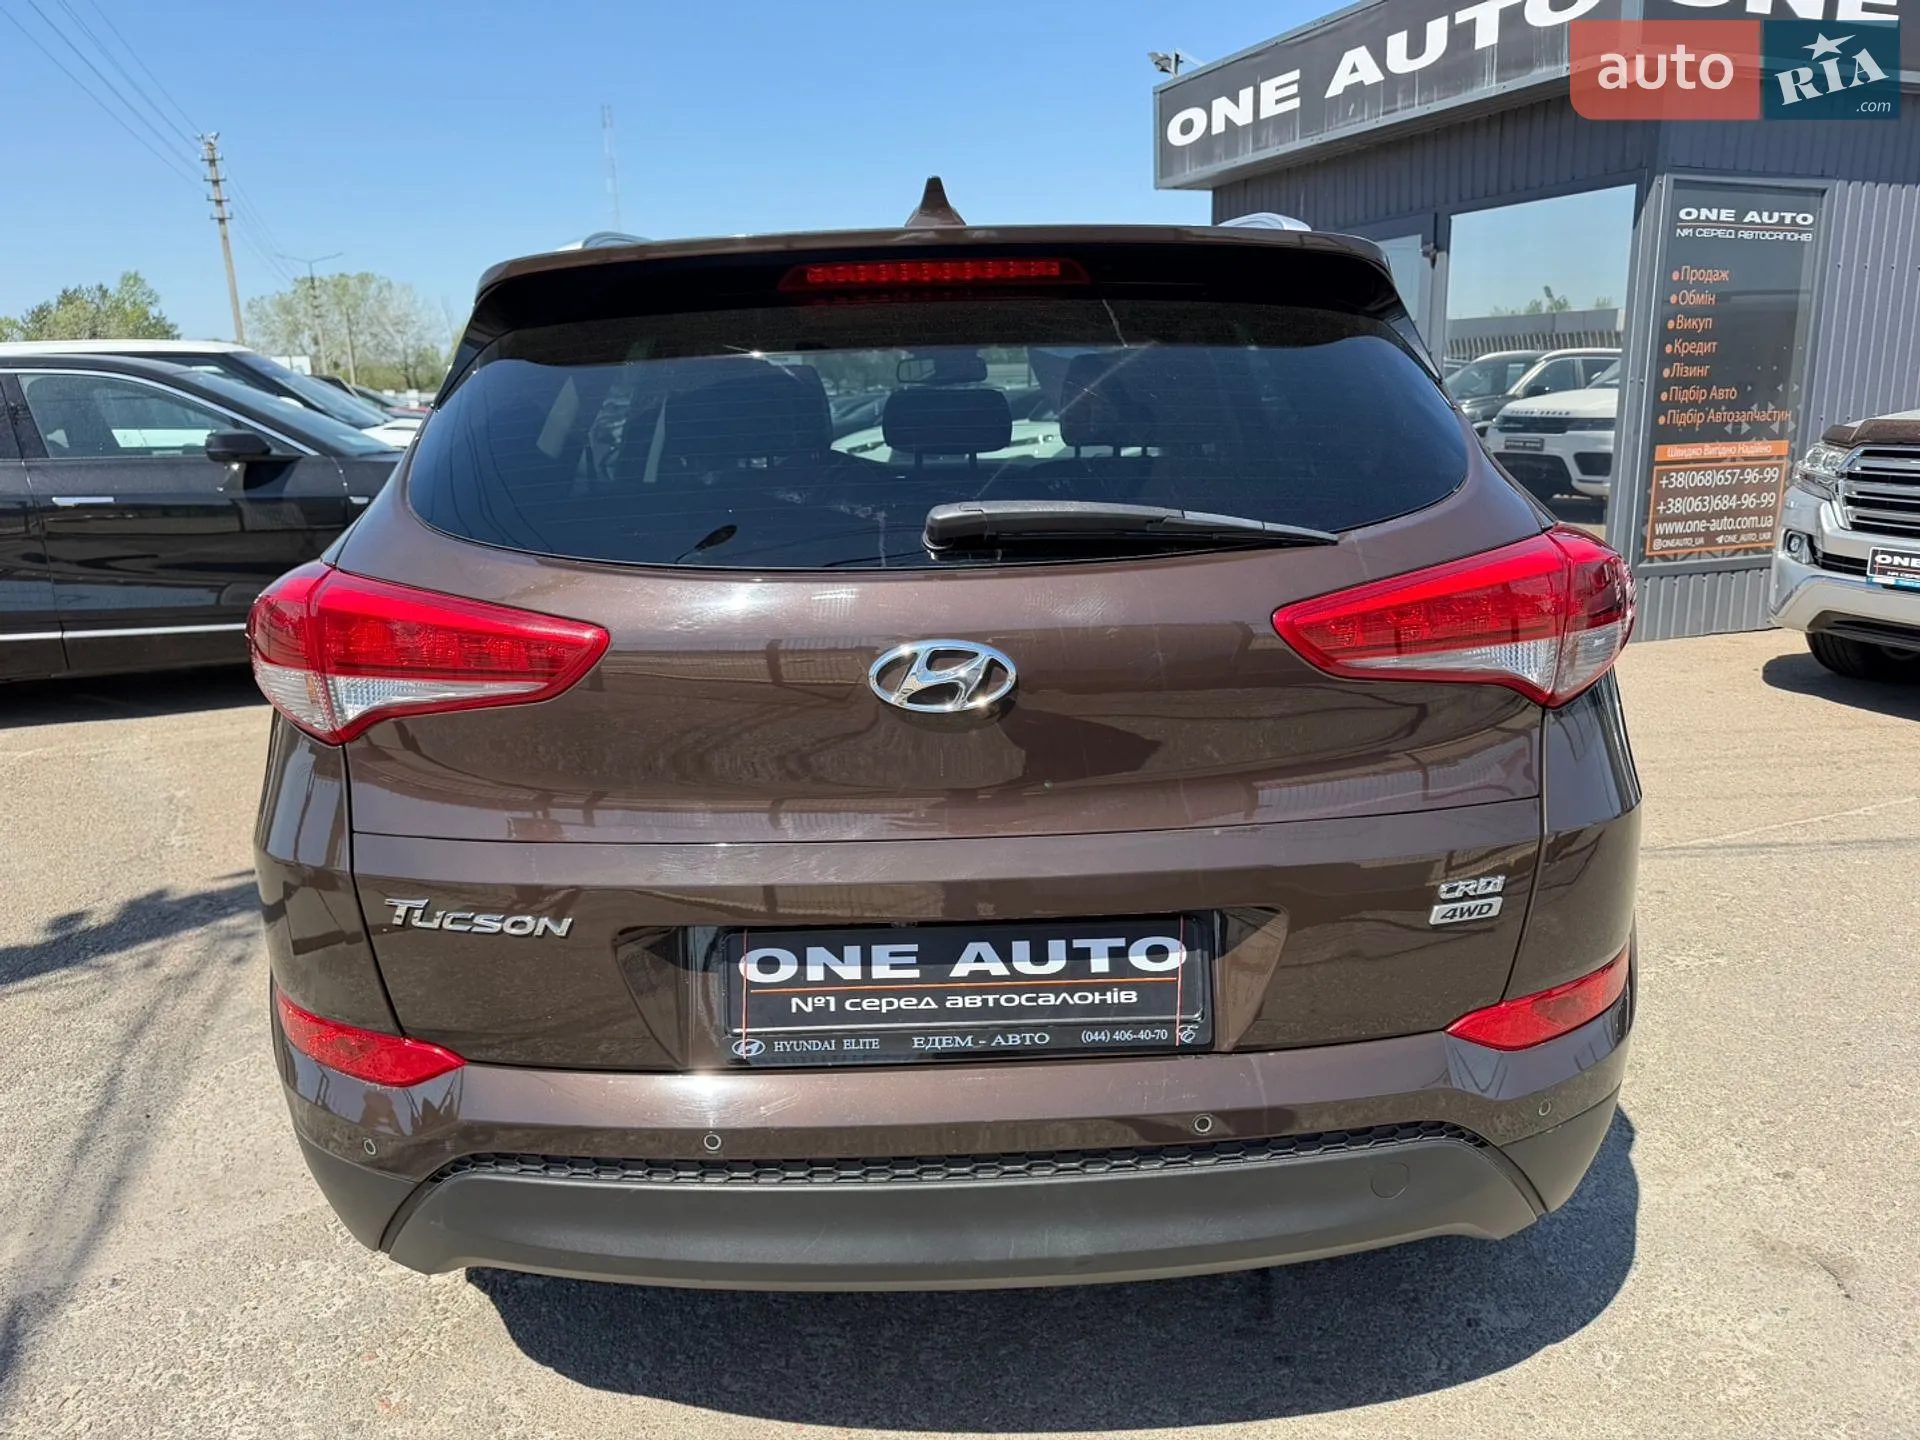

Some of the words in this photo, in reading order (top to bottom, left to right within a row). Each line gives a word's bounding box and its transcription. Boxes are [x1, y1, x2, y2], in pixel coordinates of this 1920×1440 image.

[1167, 69, 1300, 146] ONE
[1679, 207, 1736, 221] ONE
[1743, 211, 1815, 225] AUTO
[1680, 266, 1730, 284] Продаж
[1678, 290, 1716, 305] Обмін
[1676, 314, 1713, 333] Викуп
[1673, 338, 1718, 356] Кредит
[1670, 362, 1710, 378] Лізинг
[1669, 386, 1707, 403] Підбір
[1709, 385, 1737, 400] Авто
[1666, 410, 1704, 427] Підбір
[1659, 467, 1780, 489] +38(068)657-96-99
[1657, 492, 1776, 515] +38(063)684-96-99
[1655, 515, 1773, 535] www.one-auto.com.ua
[1440, 902, 1494, 920] 4WD
[738, 943, 920, 983] ONE
[949, 936, 1188, 978] AUTO
[774, 1040, 836, 1052] HYUNDAI
[842, 1038, 881, 1050] ELITE
[912, 1036, 973, 1050] ЕДЕМ
[991, 1032, 1051, 1047] АВТО
[1081, 1030, 1110, 1043] (044)
[1113, 1029, 1168, 1041] 406-40-70
